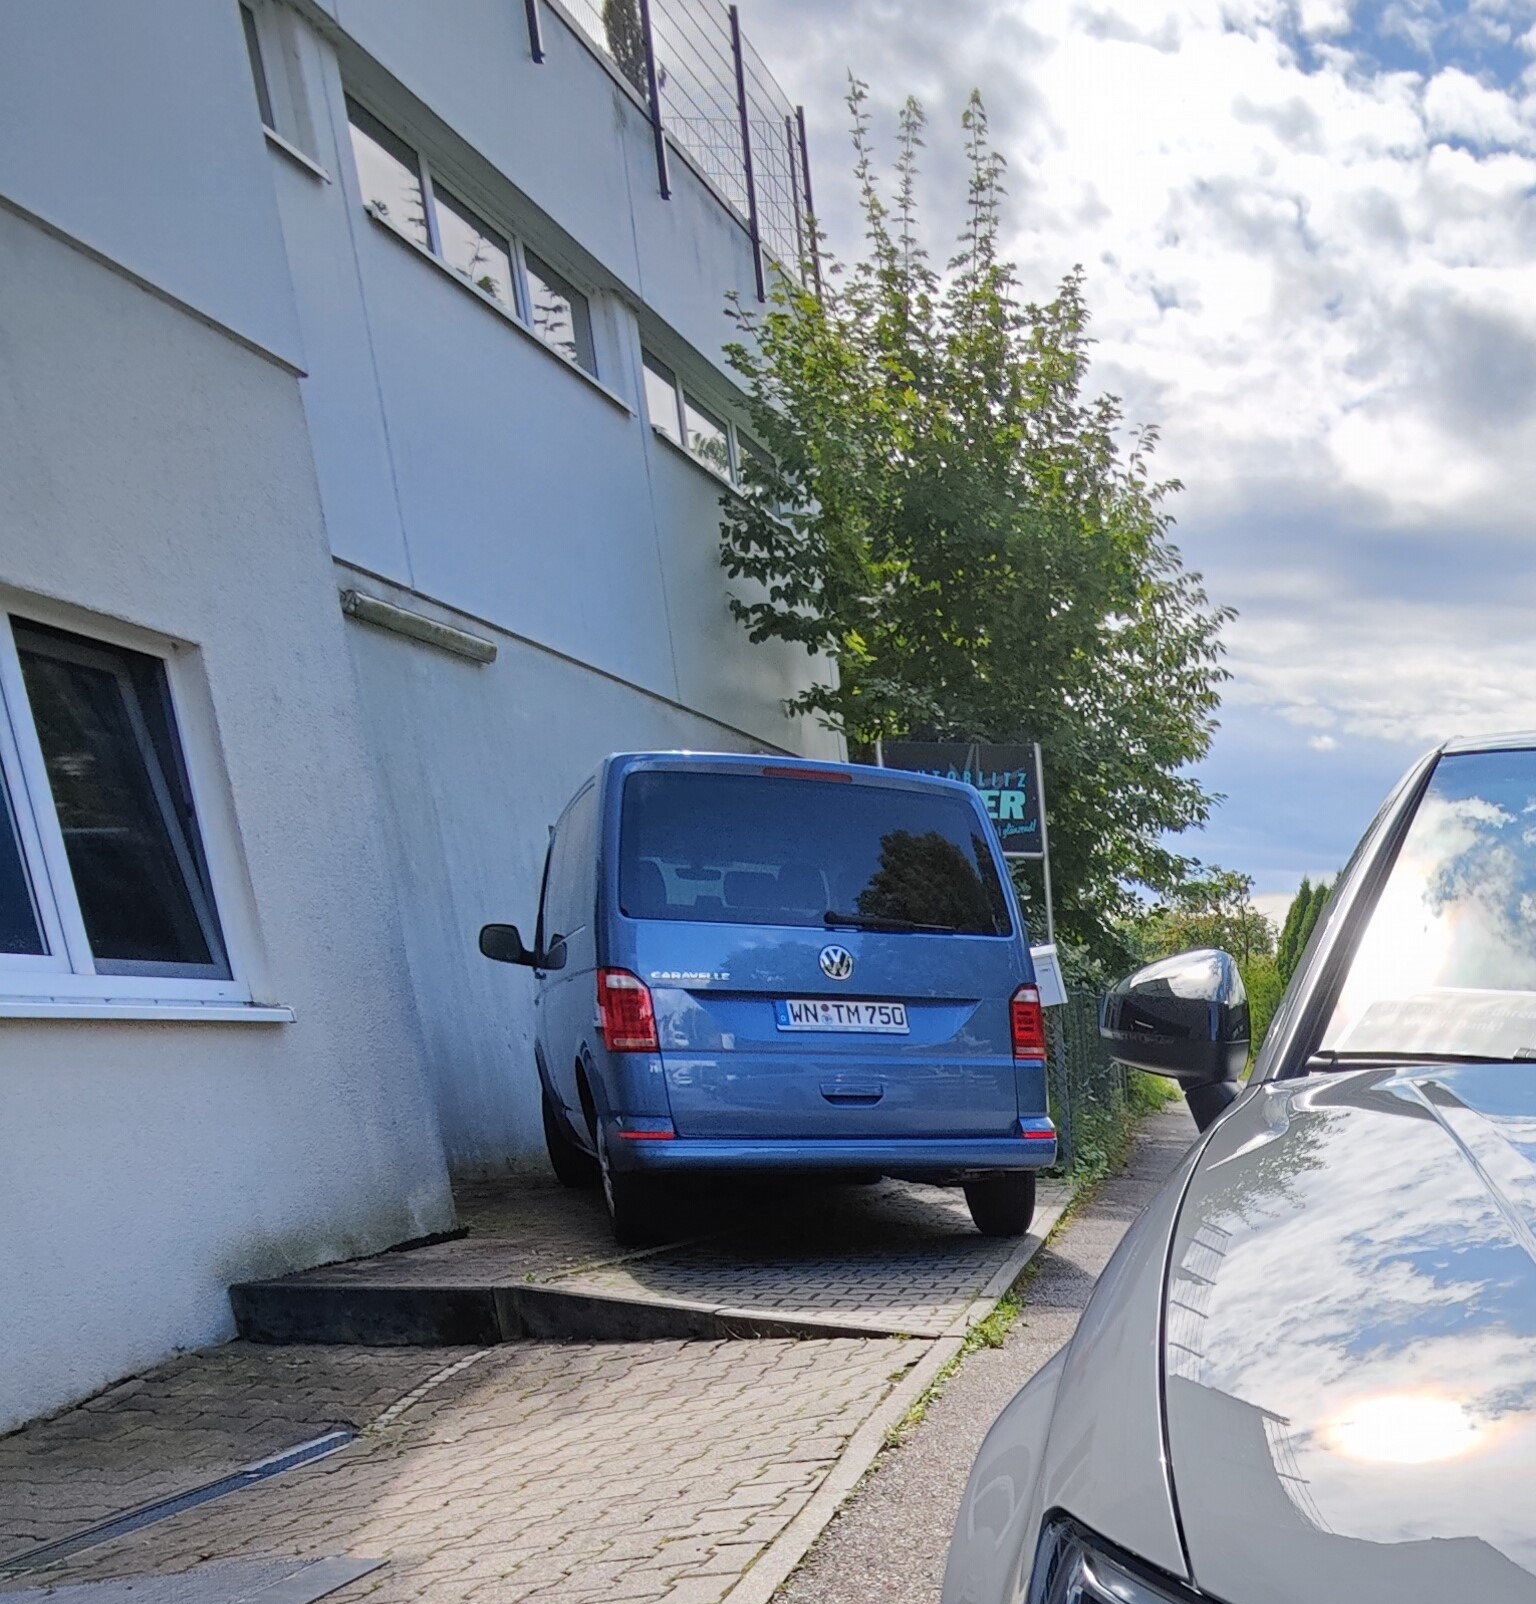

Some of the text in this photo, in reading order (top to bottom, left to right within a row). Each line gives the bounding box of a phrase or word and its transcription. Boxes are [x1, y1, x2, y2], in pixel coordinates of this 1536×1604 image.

[650, 970, 731, 981] CARAVELLE
[789, 1003, 905, 1026] WN TM 750
